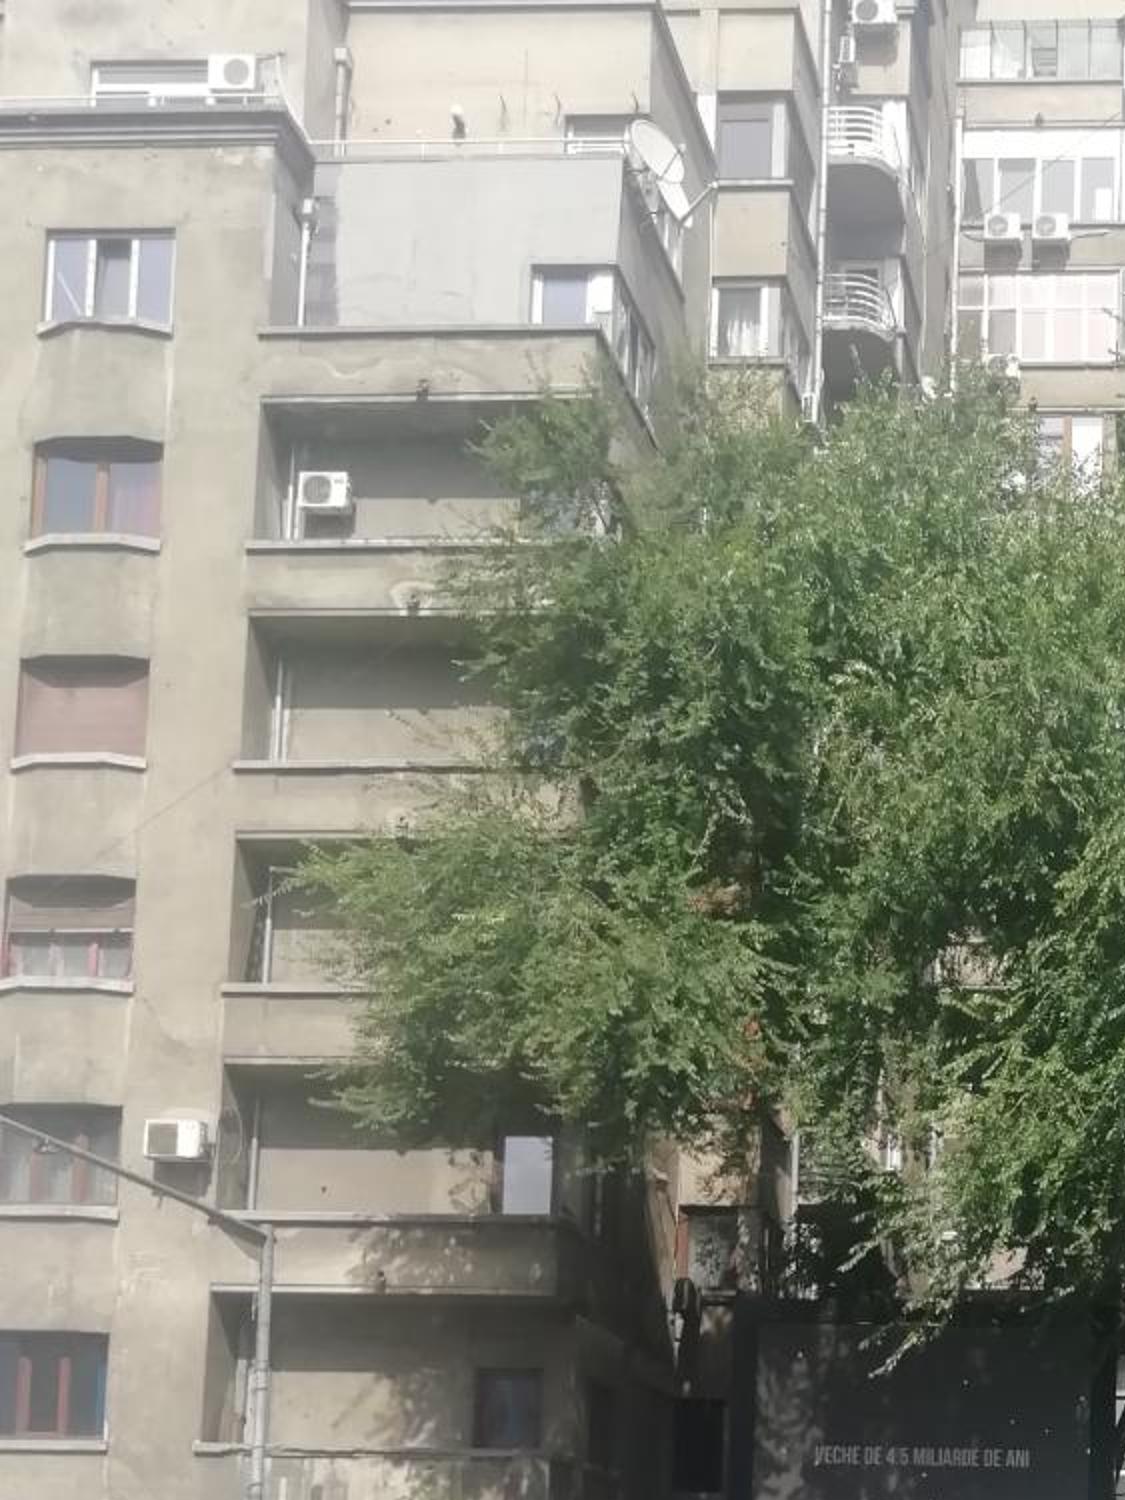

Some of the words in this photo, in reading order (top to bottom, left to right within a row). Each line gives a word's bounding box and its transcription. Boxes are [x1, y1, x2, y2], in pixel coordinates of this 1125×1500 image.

[863, 1445, 882, 1465] DE
[912, 1447, 980, 1467] MILIARDE
[983, 1449, 1004, 1468] DE
[1006, 1449, 1030, 1468] ANI
